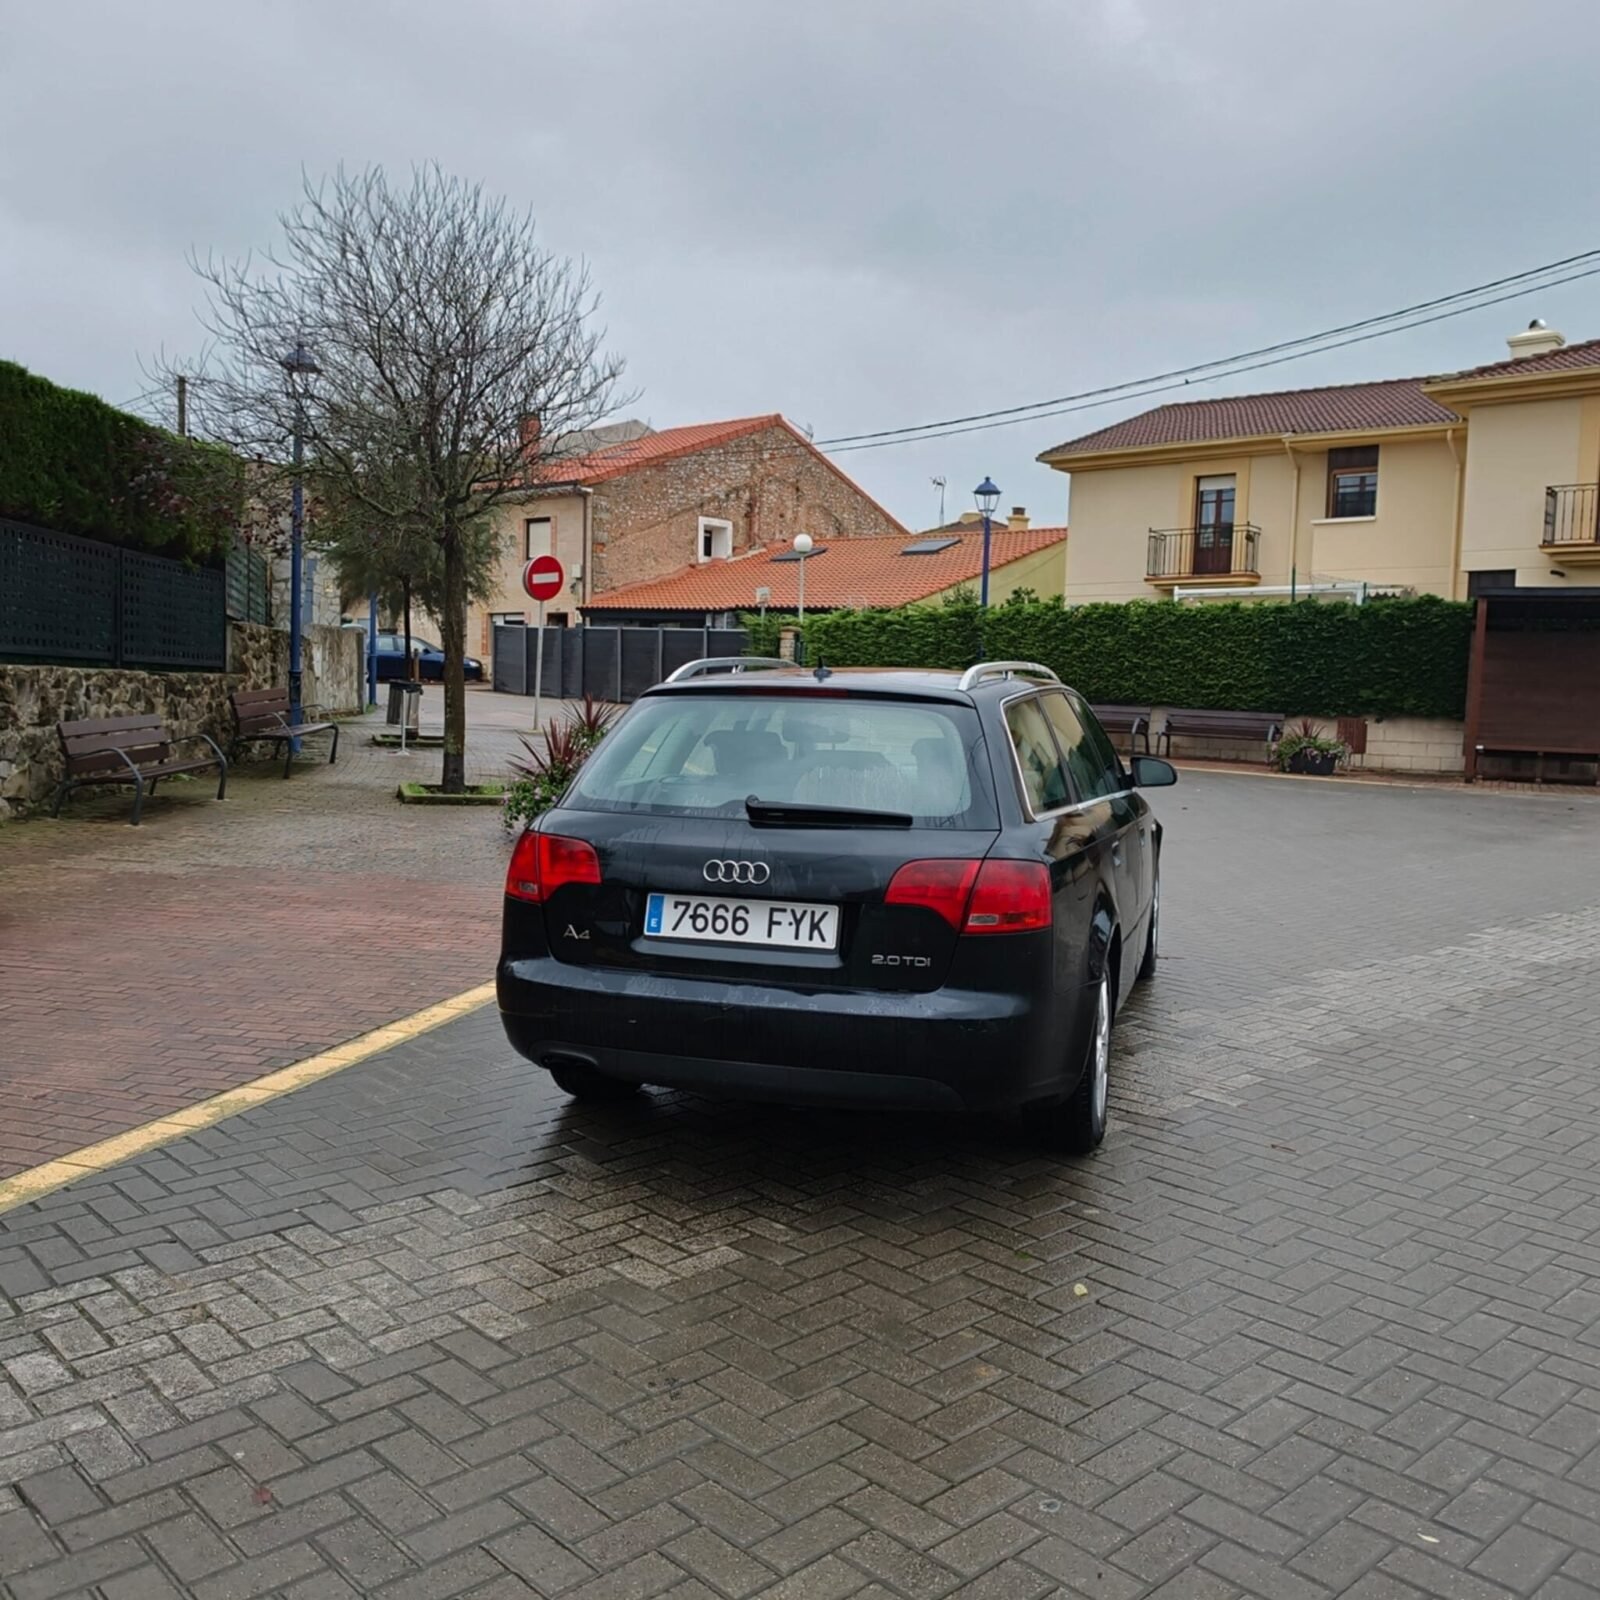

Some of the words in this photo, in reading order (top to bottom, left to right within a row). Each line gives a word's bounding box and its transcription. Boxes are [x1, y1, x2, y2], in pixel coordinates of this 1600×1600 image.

[650, 918, 658, 927] E
[671, 900, 750, 936] 7666
[766, 906, 829, 943] FYK
[563, 923, 590, 939] A4
[871, 954, 900, 966] 2.0
[901, 955, 931, 967] TDI
